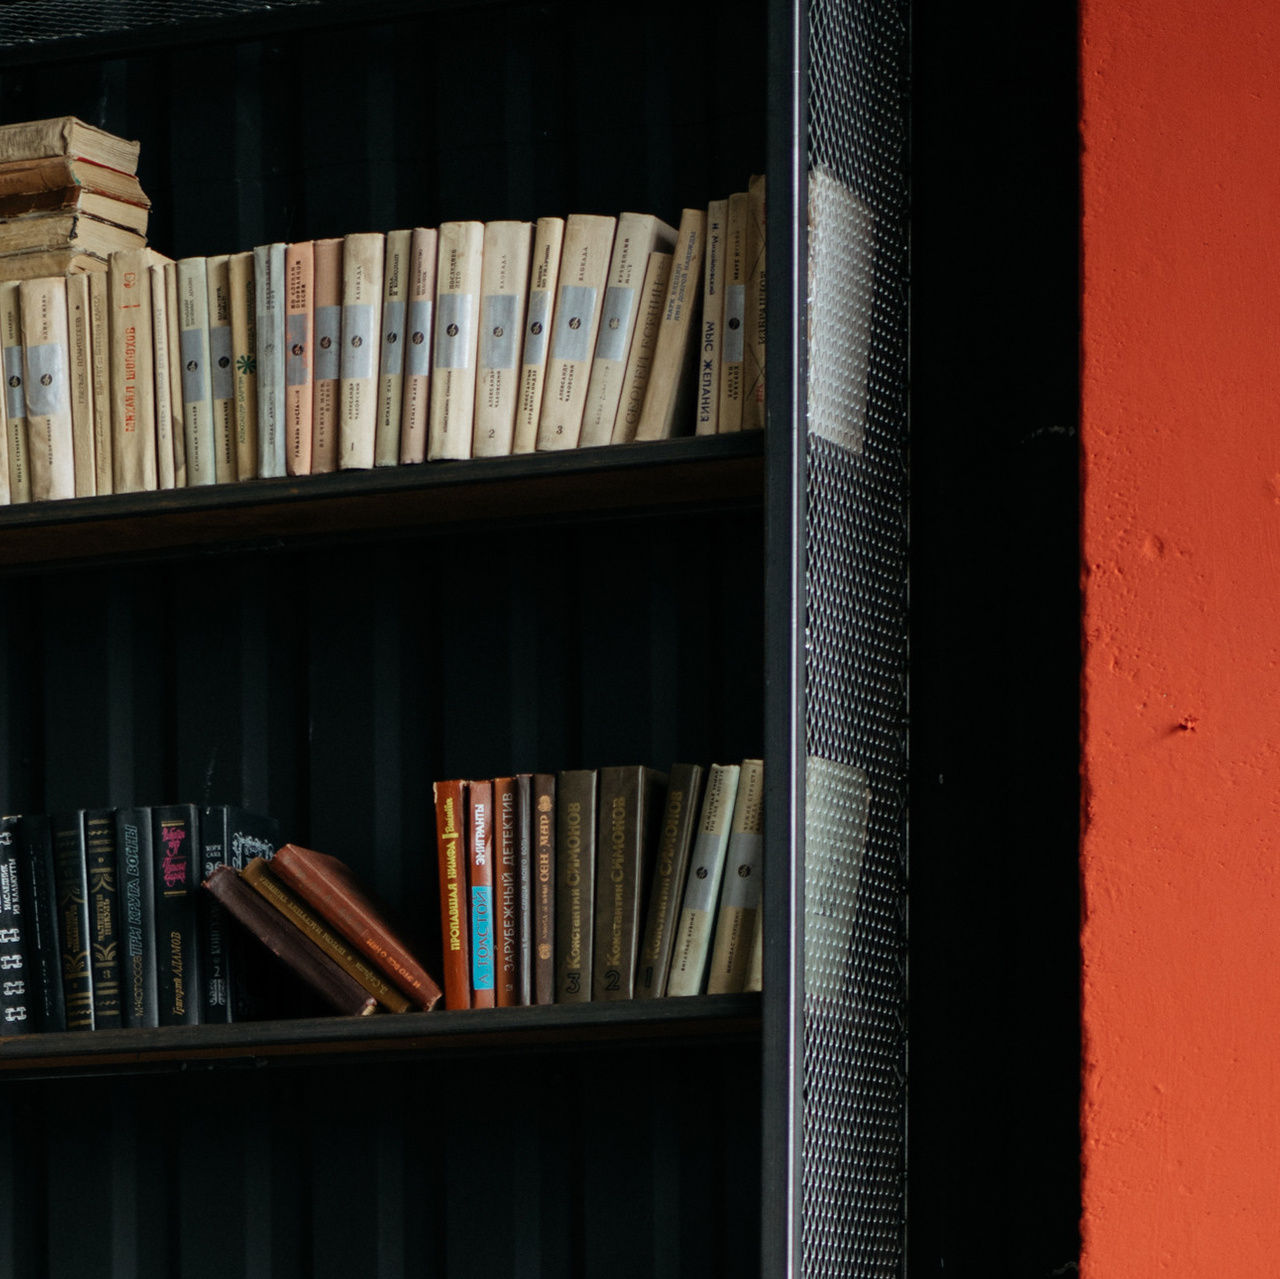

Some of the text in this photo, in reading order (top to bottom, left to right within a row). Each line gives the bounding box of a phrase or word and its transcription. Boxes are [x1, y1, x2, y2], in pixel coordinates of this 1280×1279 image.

[124, 327, 136, 432] МИХАИЛ ШОЛОХОВ
[700, 321, 715, 422] МЫС ЖЕЛАНИЯ
[474, 803, 486, 866] ЭМИГРАНТЫ
[567, 802, 581, 886] СИМОНОВ
[611, 796, 626, 882] СИМОНОВ
[659, 790, 683, 876] СИМОНОВ
[125, 825, 142, 956] ТРИ КРУГА ВОЙНЫ
[446, 840, 461, 950] ПРОПАВШАЯ НИМФА
[501, 793, 515, 971] ЗАРУБЕЖНЫЙ ДЕТЕКТИВ
[171, 932, 182, 976] АДАМОВ
